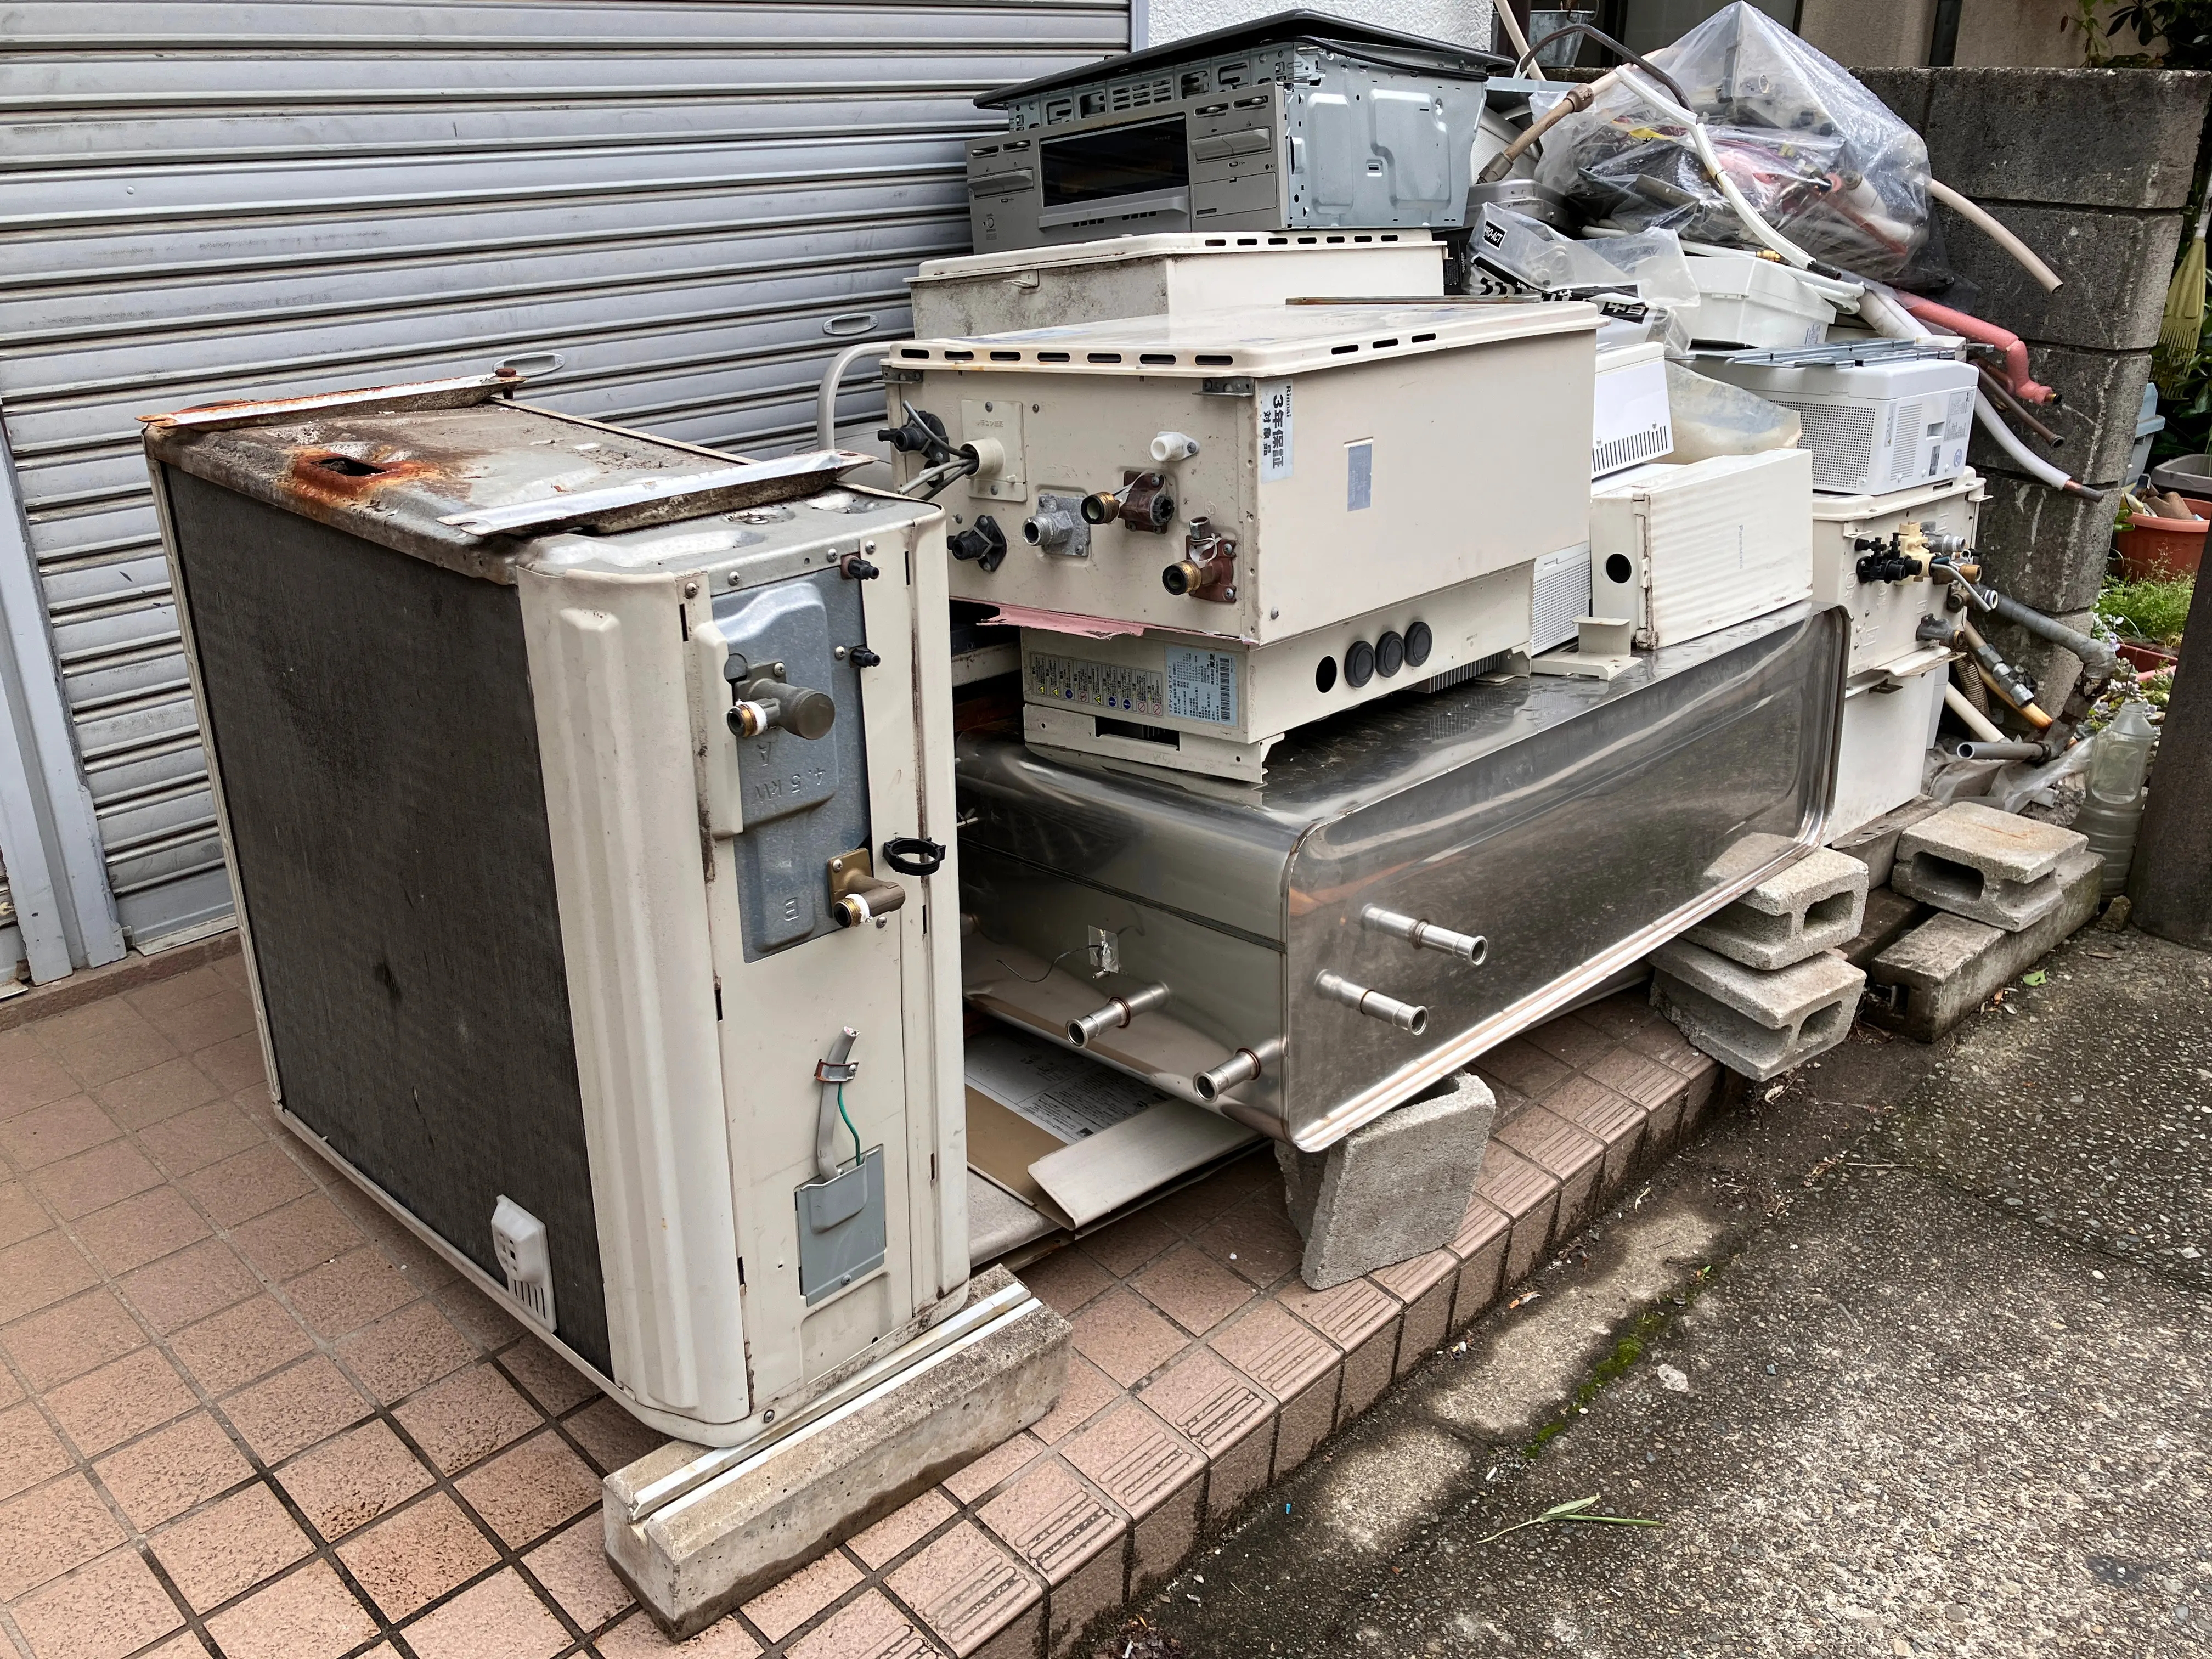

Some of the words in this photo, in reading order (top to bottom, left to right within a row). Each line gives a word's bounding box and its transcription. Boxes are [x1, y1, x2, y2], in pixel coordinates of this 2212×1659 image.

[1272, 394, 1284, 469] 3年保証
[783, 896, 800, 922] B
